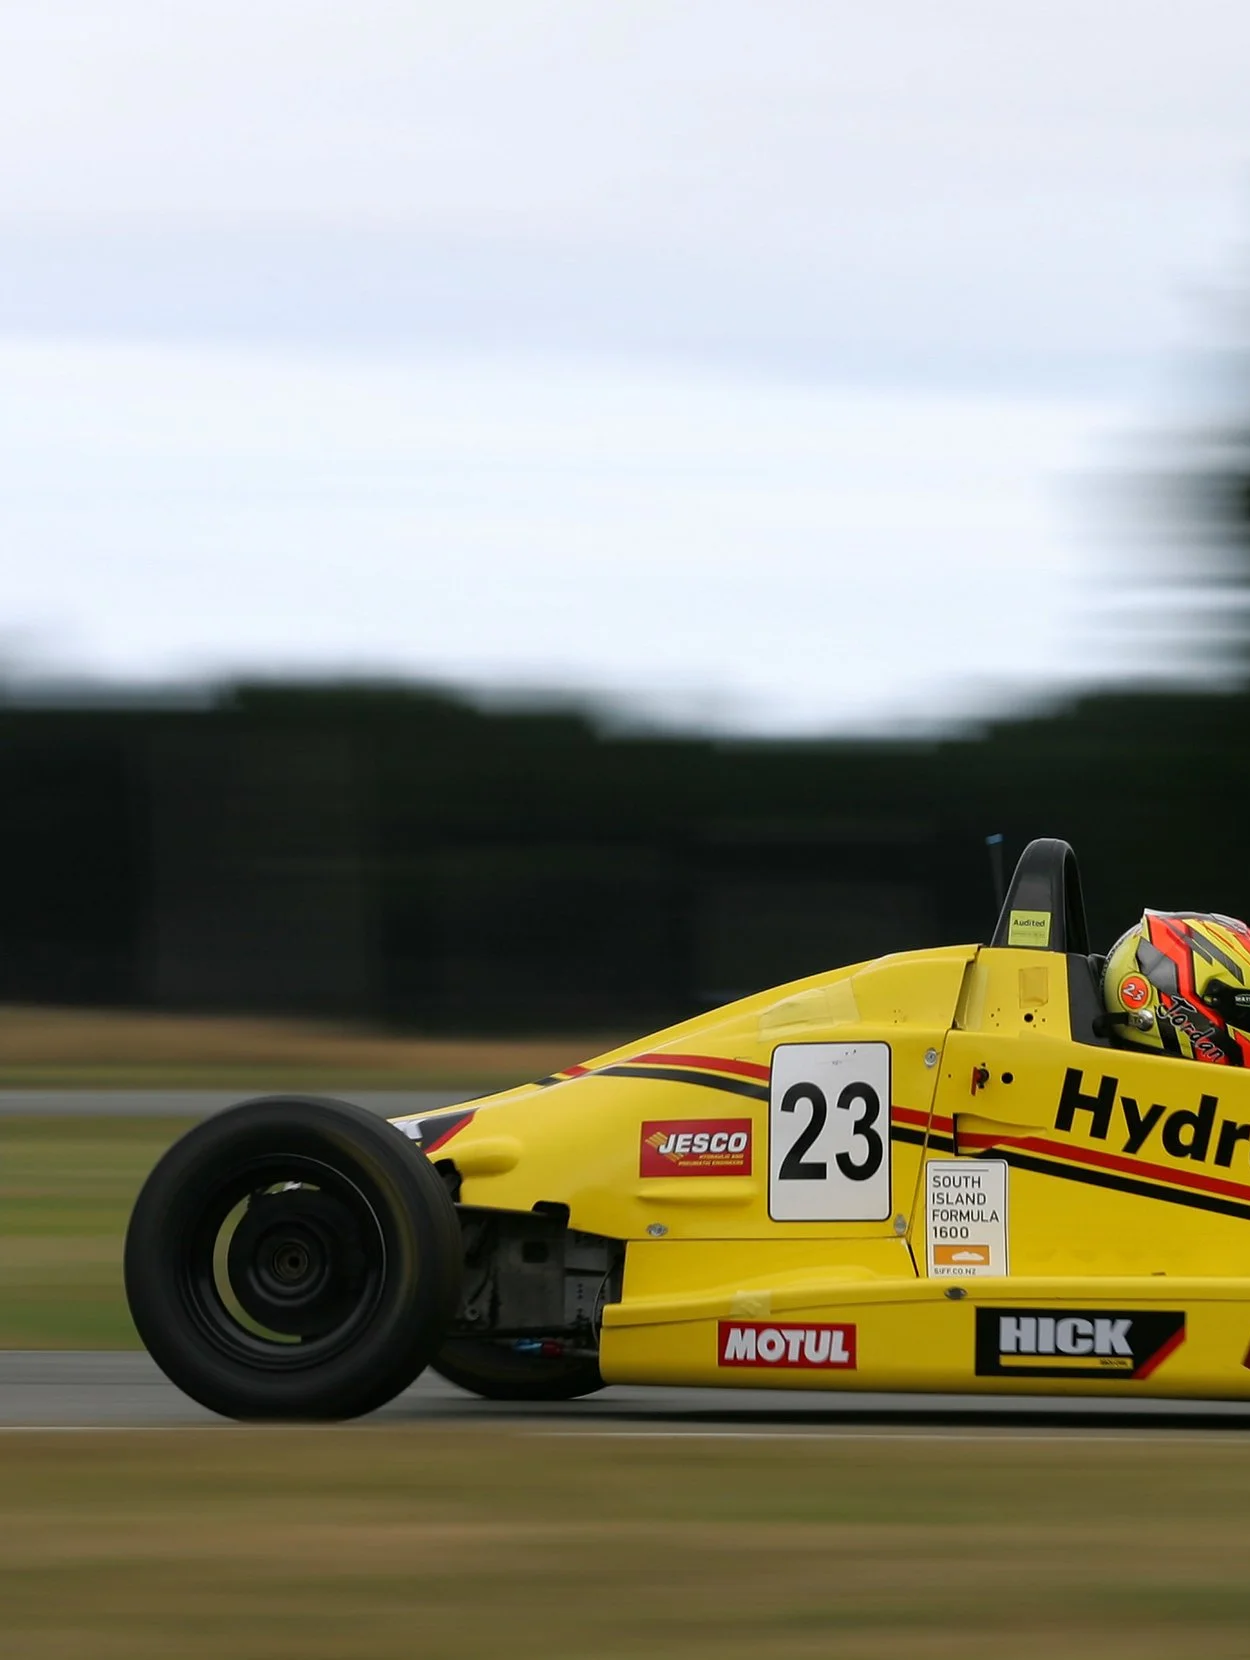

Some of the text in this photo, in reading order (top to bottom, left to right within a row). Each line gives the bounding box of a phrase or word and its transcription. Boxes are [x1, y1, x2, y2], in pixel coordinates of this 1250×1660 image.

[1013, 919, 1046, 928] Audited
[1122, 983, 1145, 1001] 23
[1156, 994, 1226, 1063] Jordan
[778, 1081, 884, 1182] 23
[658, 1131, 748, 1155] JESCO
[932, 1175, 982, 1189] SOUTH
[931, 1192, 987, 1206] ISLAND
[931, 1209, 1000, 1223] FORMULA
[932, 1225, 970, 1239] 1600
[999, 1316, 1134, 1356] HICK
[723, 1328, 850, 1364] MOTUL
